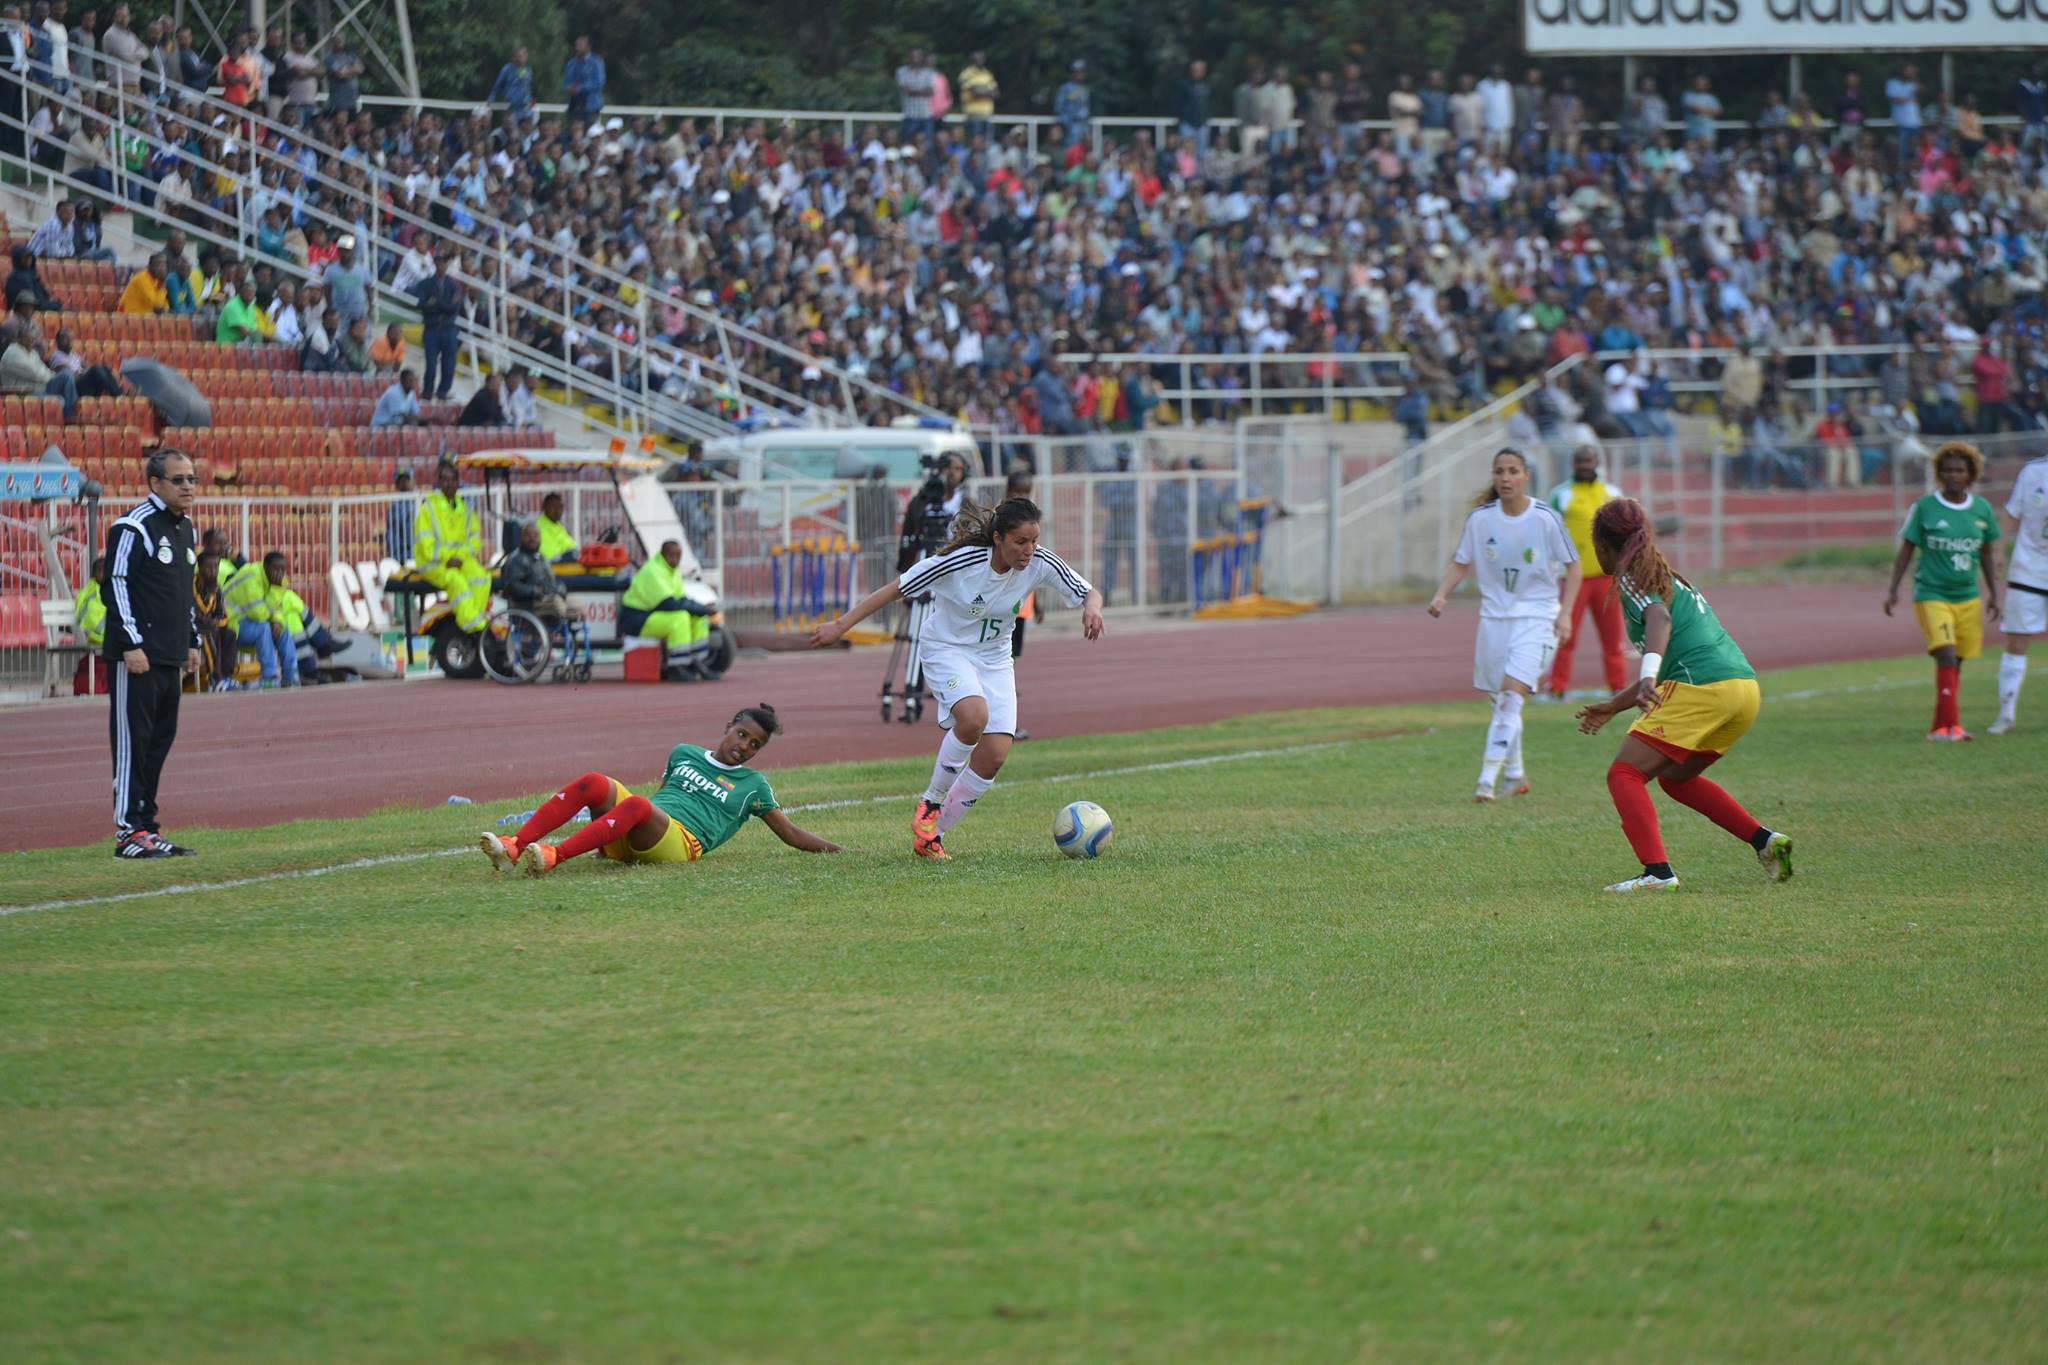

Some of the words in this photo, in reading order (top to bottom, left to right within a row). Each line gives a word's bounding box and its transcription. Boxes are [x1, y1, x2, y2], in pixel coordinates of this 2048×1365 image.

[1503, 567, 1520, 593] 17
[581, 602, 618, 621] 039
[979, 618, 1002, 643] 15
